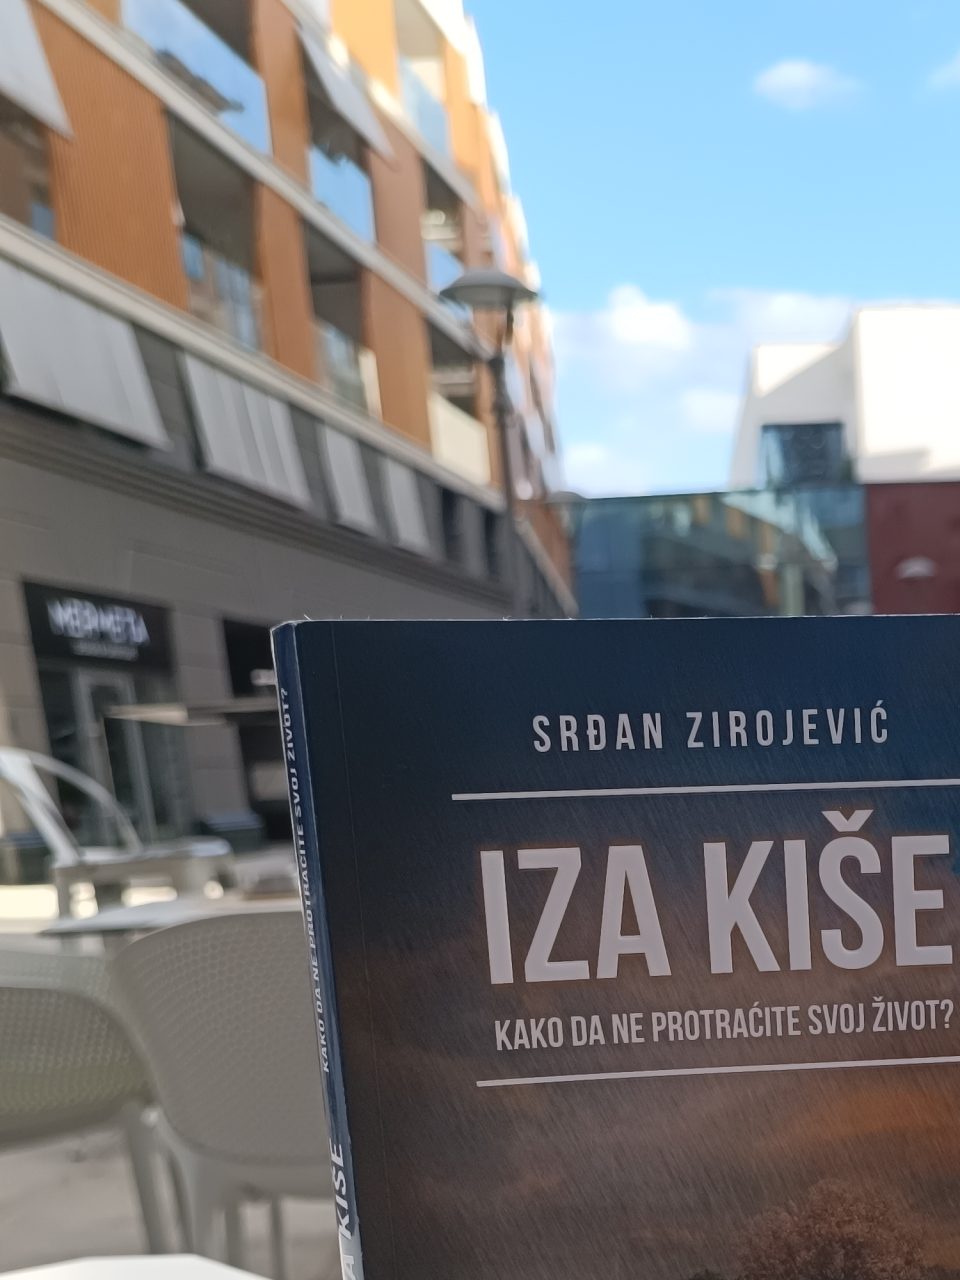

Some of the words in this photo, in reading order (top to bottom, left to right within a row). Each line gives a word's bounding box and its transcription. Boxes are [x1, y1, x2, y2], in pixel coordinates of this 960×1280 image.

[532, 712, 663, 752] SRĐAN
[686, 700, 889, 749] ZIROJEVIĆ
[290, 767, 302, 818] SVOJ
[480, 844, 672, 984] IZA
[703, 809, 954, 974] KIŠE
[318, 1018, 330, 1074] KAKO
[494, 1016, 563, 1051] KAKO
[571, 1013, 606, 1046] DA
[612, 1012, 645, 1044] NE
[652, 1001, 801, 1042] PROTRAĆITE
[808, 1001, 865, 1035] SVOJ
[871, 995, 955, 1032] ŽIVOT?
